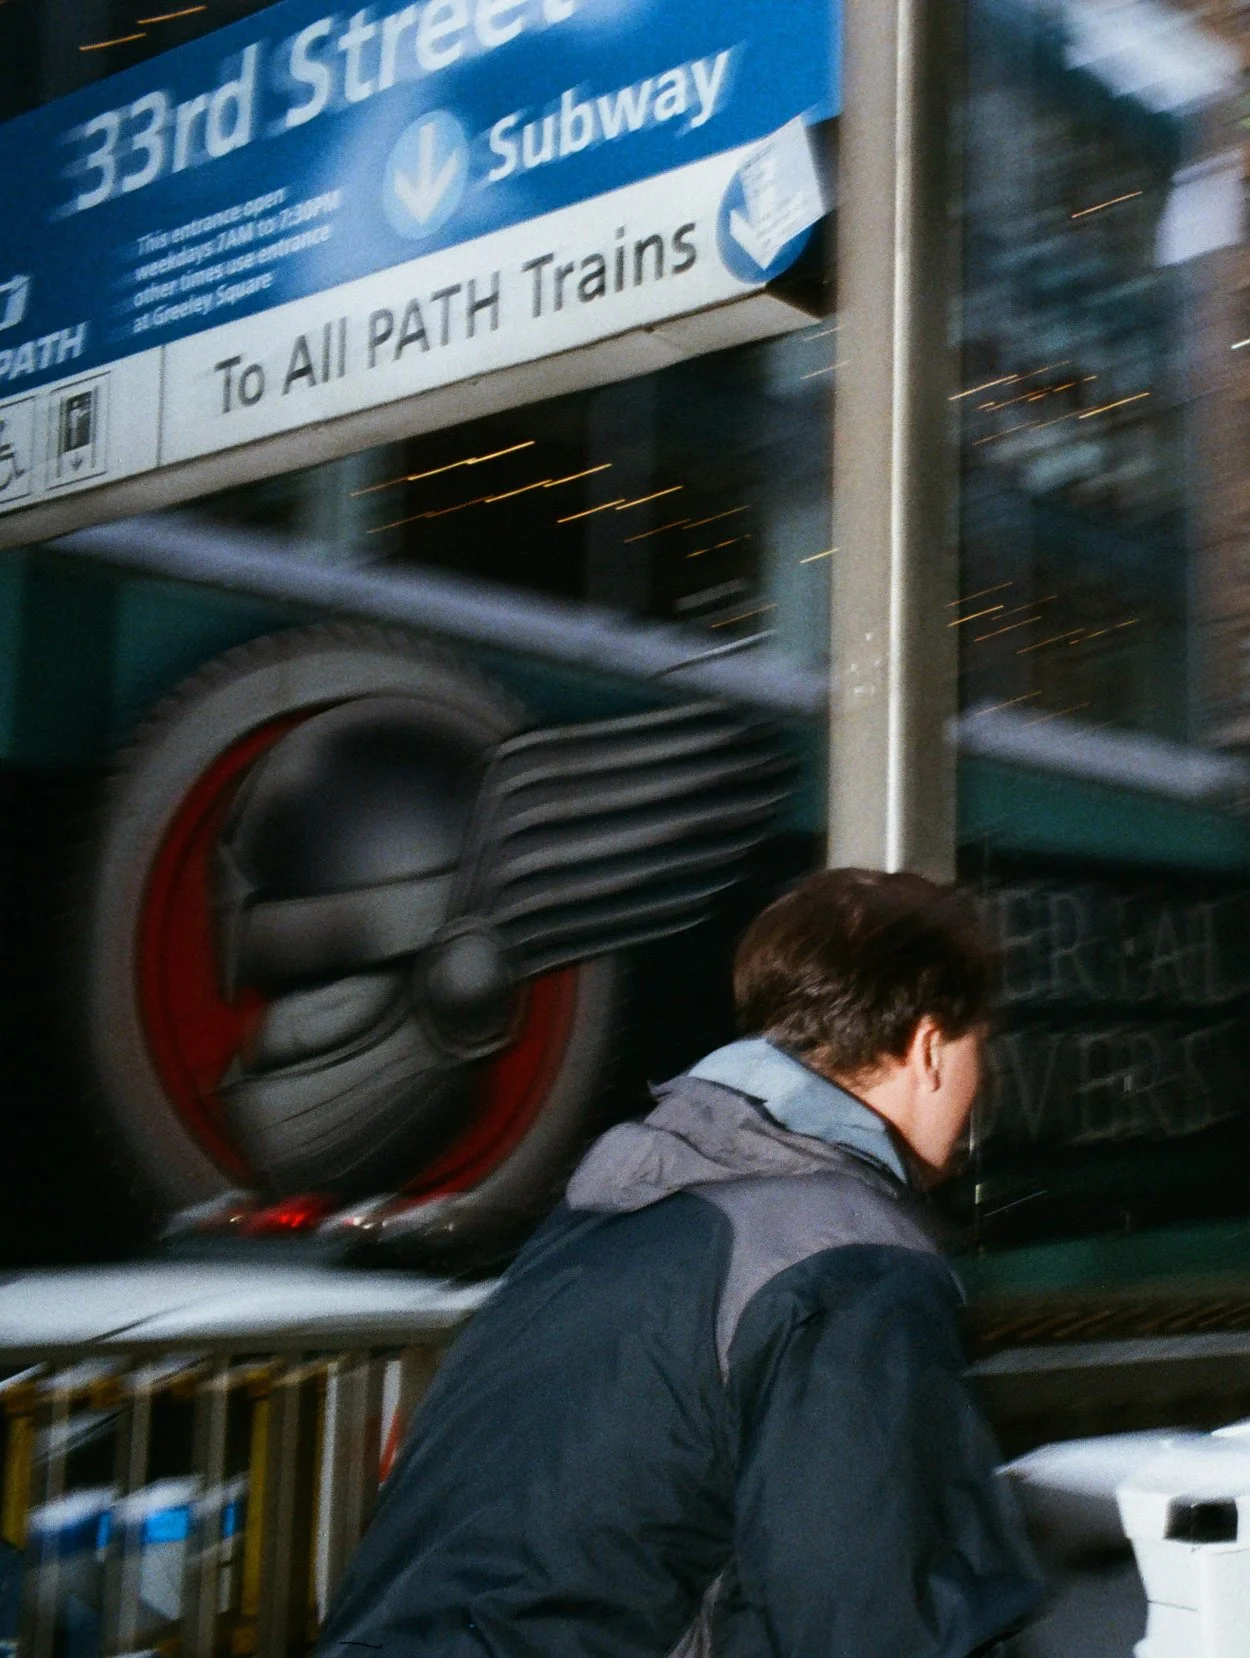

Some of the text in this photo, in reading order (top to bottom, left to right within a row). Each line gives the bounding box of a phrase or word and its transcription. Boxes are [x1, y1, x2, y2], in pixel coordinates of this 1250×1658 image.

[76, 41, 260, 210] 33rd
[489, 50, 730, 182] Subway
[135, 240, 213, 282] weekdays
[216, 221, 254, 251] 7AM
[254, 216, 276, 238] to
[137, 187, 286, 256] This entrance open
[133, 225, 331, 307] other times use entrance
[133, 271, 274, 333] at Greeley Square
[214, 222, 697, 414] To All PATH Trains
